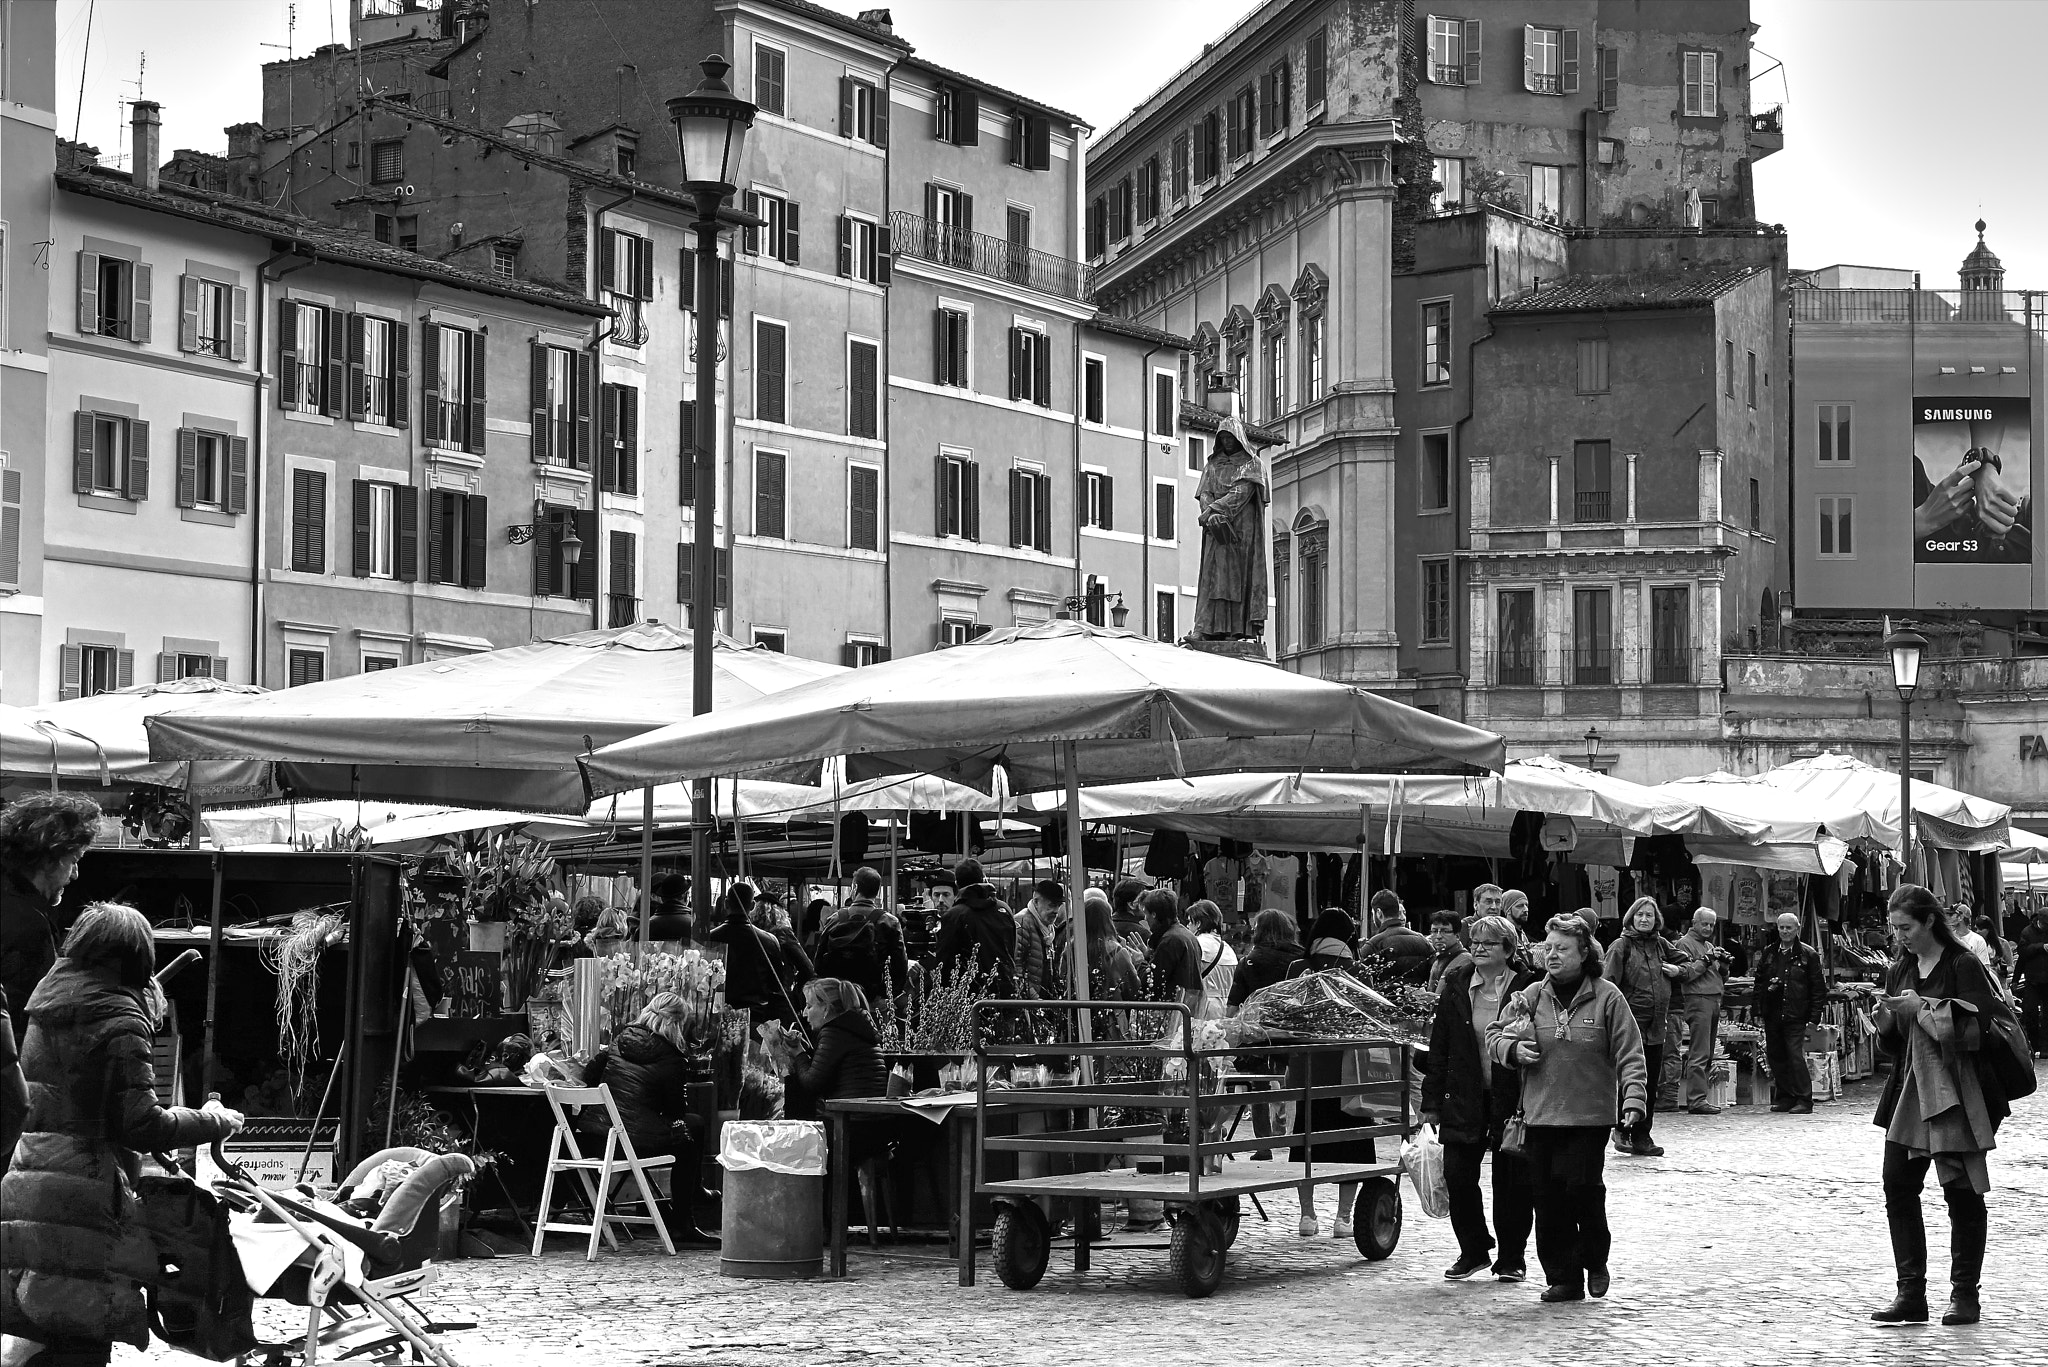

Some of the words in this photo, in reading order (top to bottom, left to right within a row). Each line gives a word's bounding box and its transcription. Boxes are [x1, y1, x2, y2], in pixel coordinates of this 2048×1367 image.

[1924, 409, 1993, 421] SAMSUNG
[1925, 540, 1960, 551] Gear
[1963, 540, 1978, 551] S3
[239, 1159, 284, 1171] superfre
